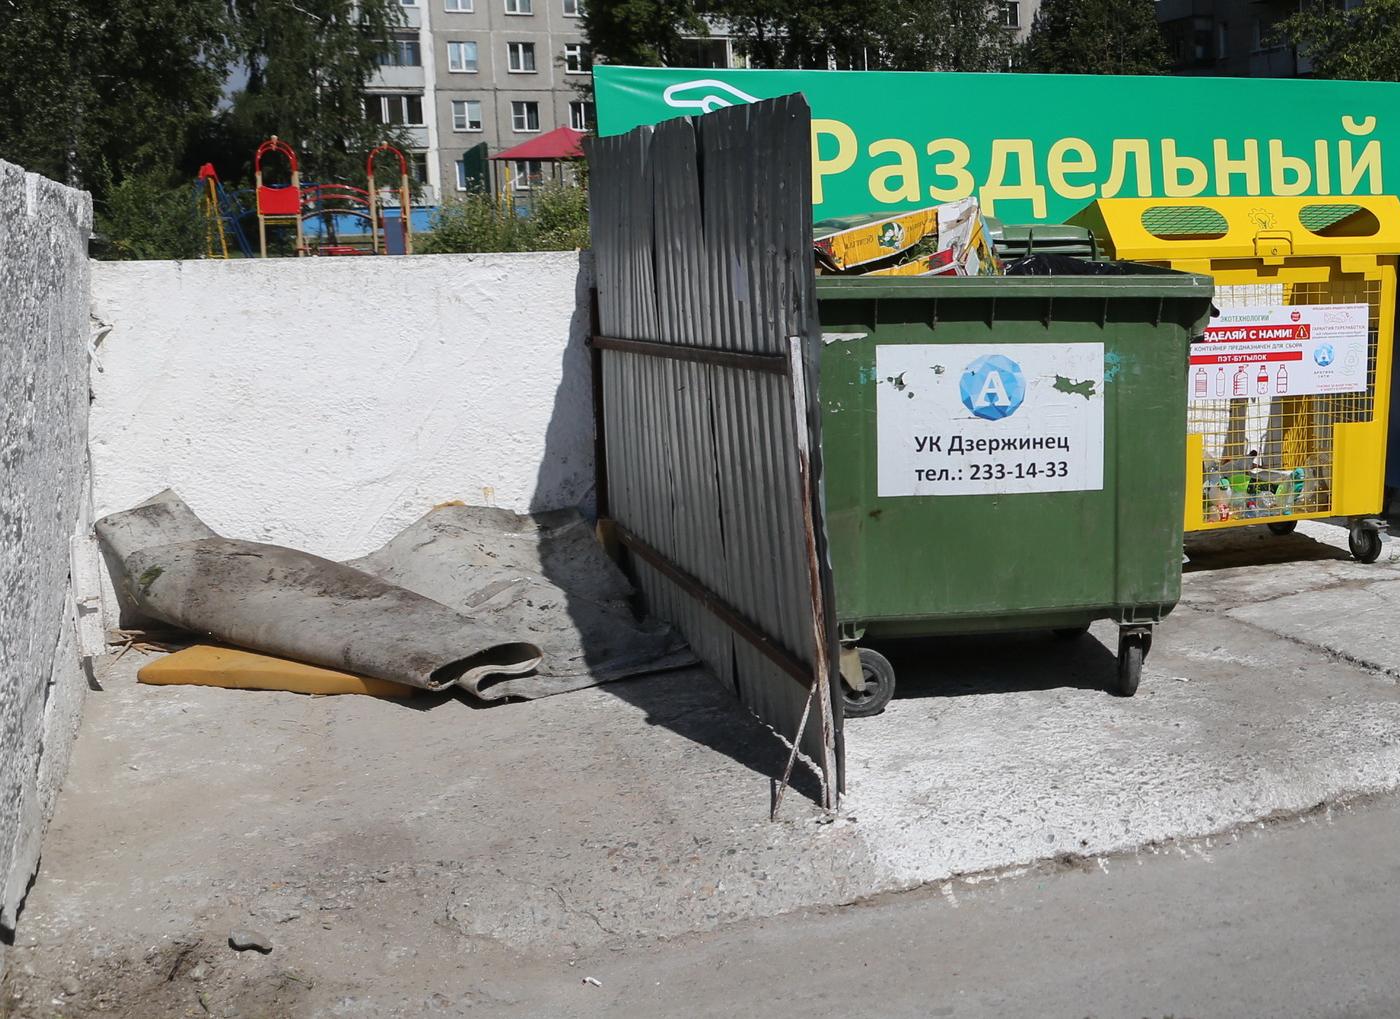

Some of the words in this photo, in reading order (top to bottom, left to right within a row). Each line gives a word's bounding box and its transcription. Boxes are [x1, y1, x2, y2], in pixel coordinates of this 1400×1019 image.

[811, 115, 1382, 220] Раздельный
[1220, 314, 1270, 323] ЭКОТЕХНОЛОГИИ
[1204, 327, 1247, 342] ЗДЕЛЯЙ
[1249, 329, 1258, 340] С
[1258, 327, 1293, 339] НАМИ!
[1228, 343, 1271, 352] ПРЕДНАЗНАЧЕН
[1217, 354, 1268, 363] ПЭТ-БУТЫЛОК
[914, 436, 942, 453] УК
[947, 435, 1070, 456] Дзержинец
[915, 467, 963, 482] тел.:
[969, 461, 1069, 481] 233-14-33
